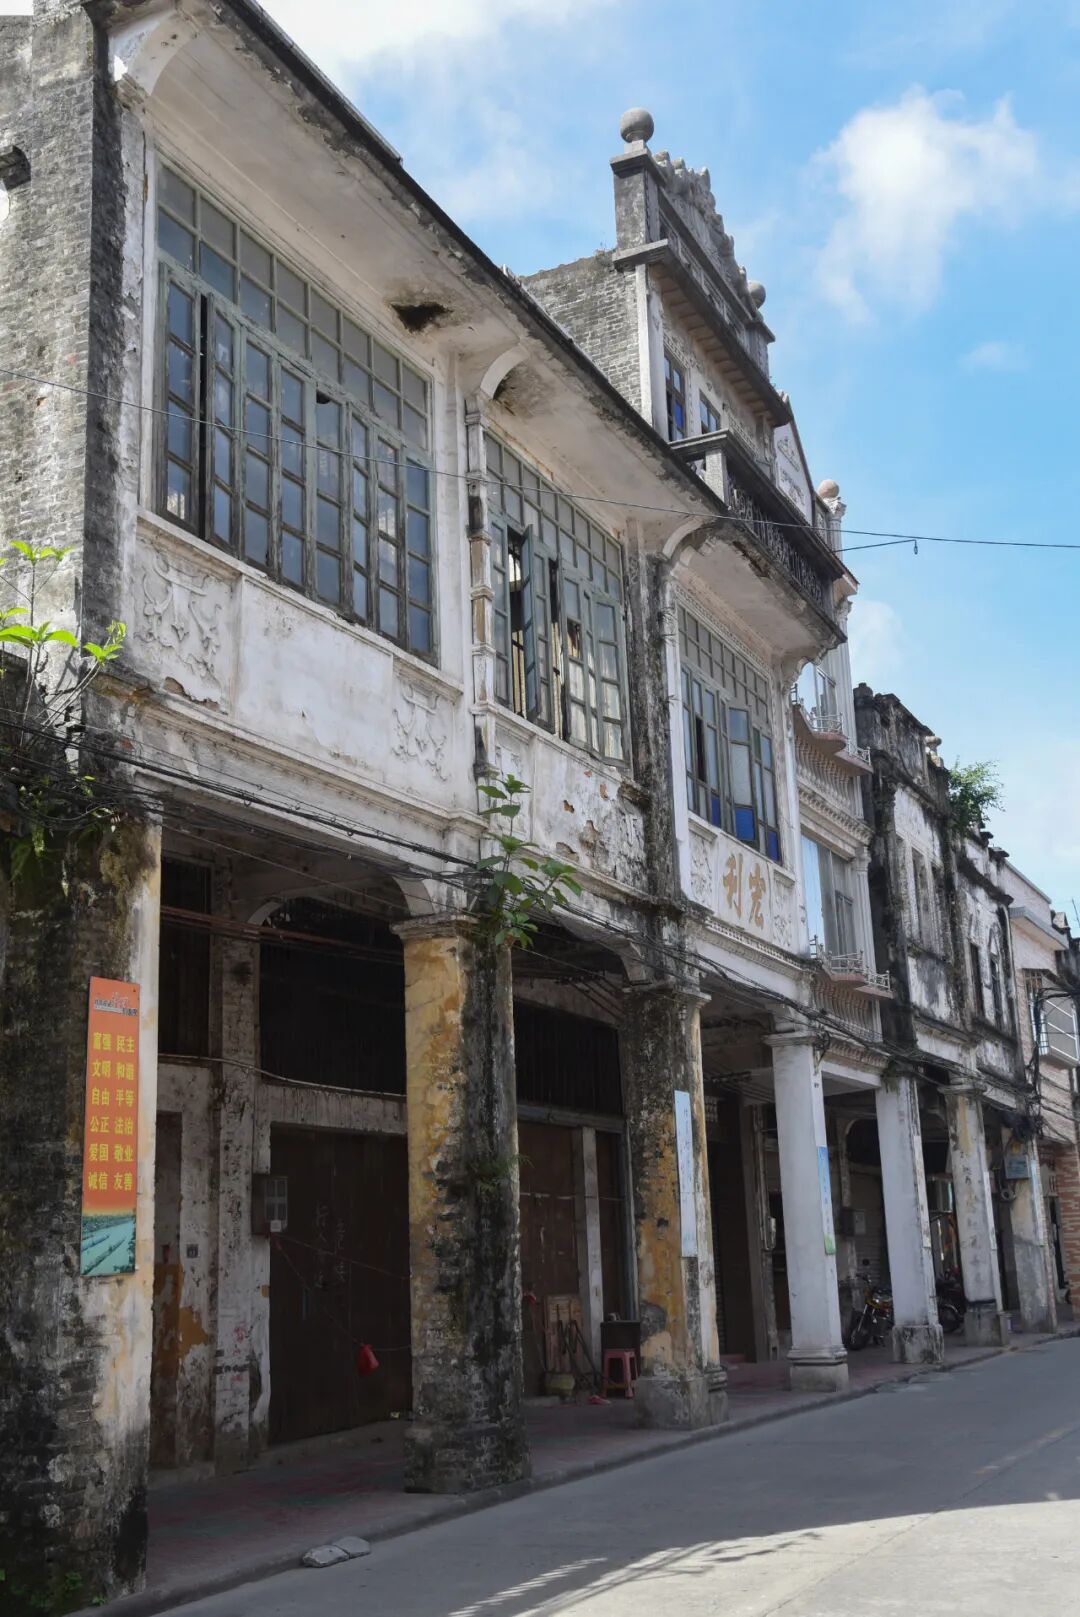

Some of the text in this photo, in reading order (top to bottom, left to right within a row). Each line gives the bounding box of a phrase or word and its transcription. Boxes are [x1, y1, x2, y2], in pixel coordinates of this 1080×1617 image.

[93, 1031, 135, 1053] 富强 民主
[92, 1058, 134, 1081] 文明 和谐
[91, 1086, 134, 1108] 自由 平等
[90, 1115, 133, 1136] 公正 法治
[89, 1142, 133, 1162] 爱国 敬业
[88, 1171, 133, 1191] 诚信 友善
